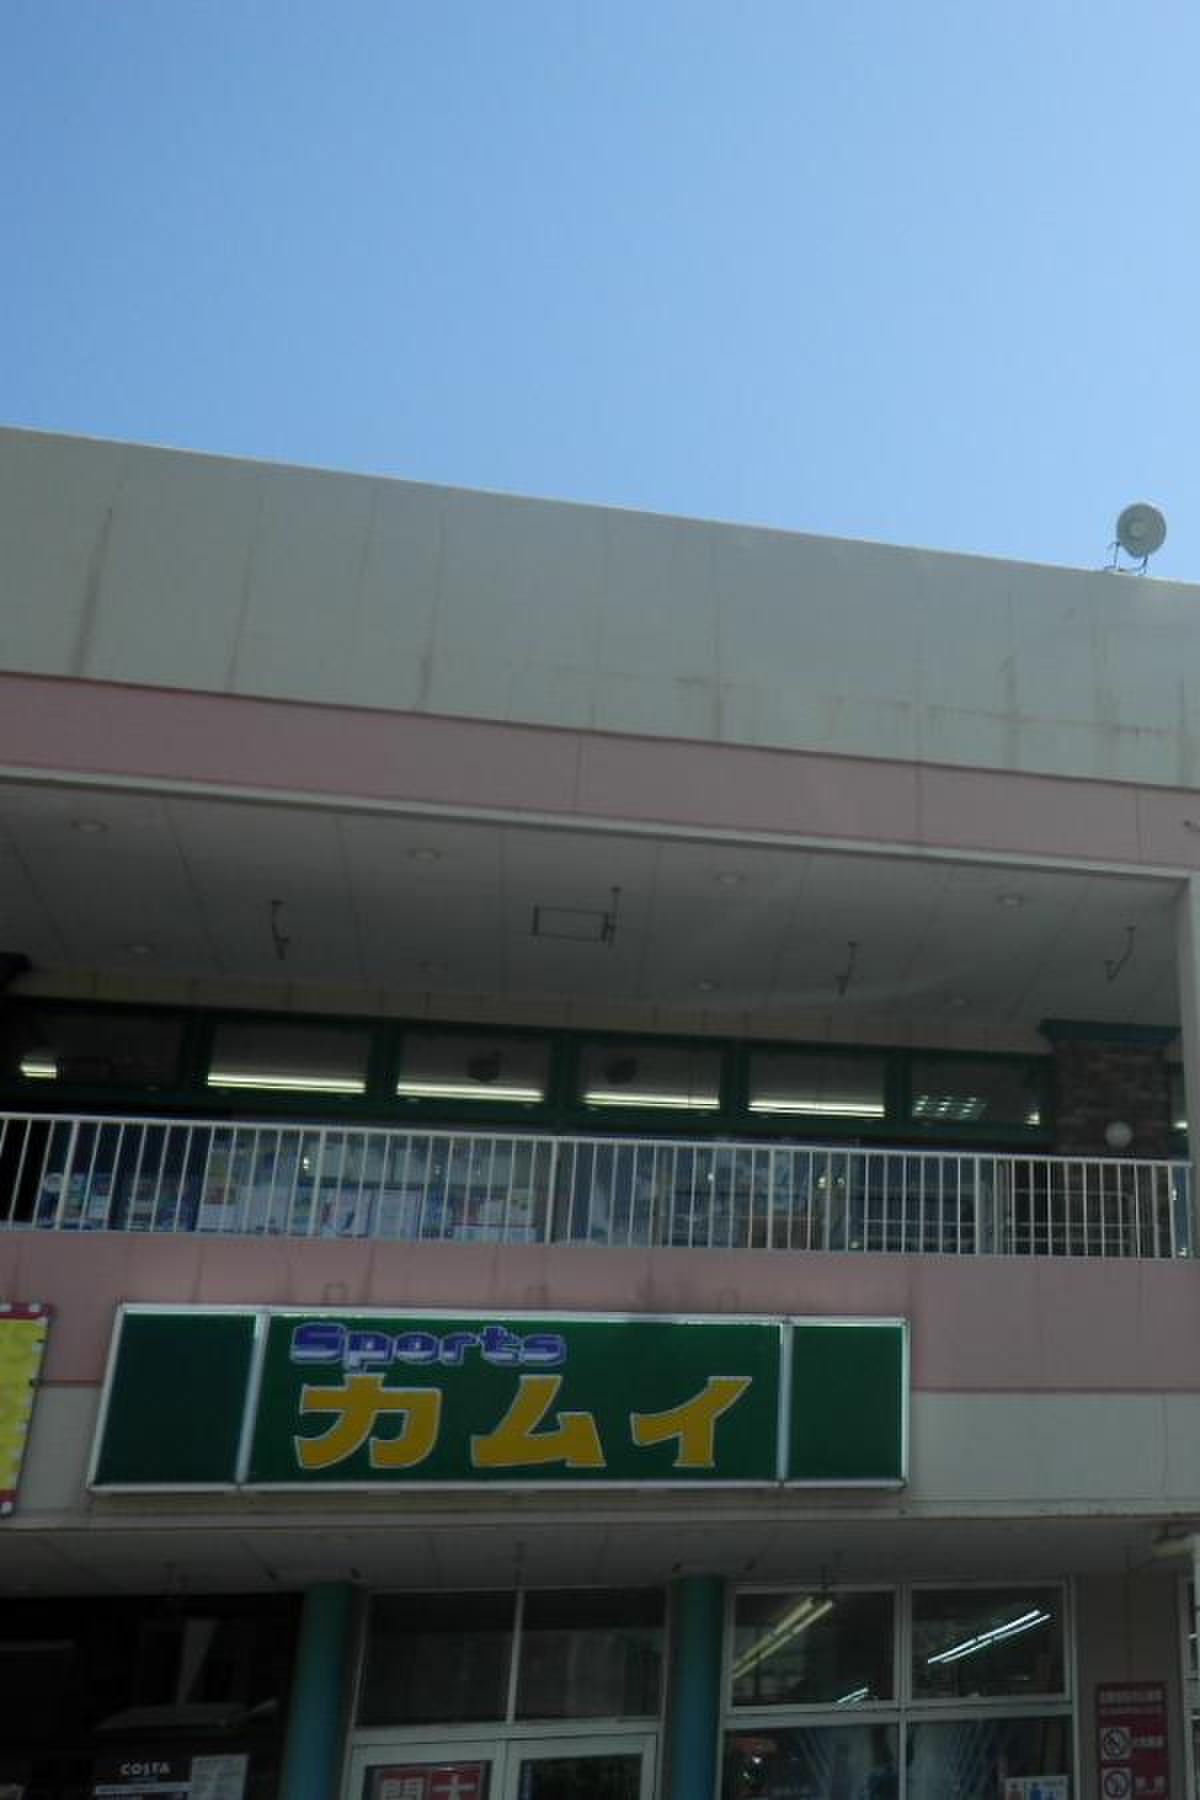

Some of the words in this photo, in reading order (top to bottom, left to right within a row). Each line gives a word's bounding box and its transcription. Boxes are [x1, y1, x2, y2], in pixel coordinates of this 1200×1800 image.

[290, 1322, 566, 1372] Sports
[294, 1373, 753, 1469] カムイ
[119, 1761, 172, 1777] COSTA
